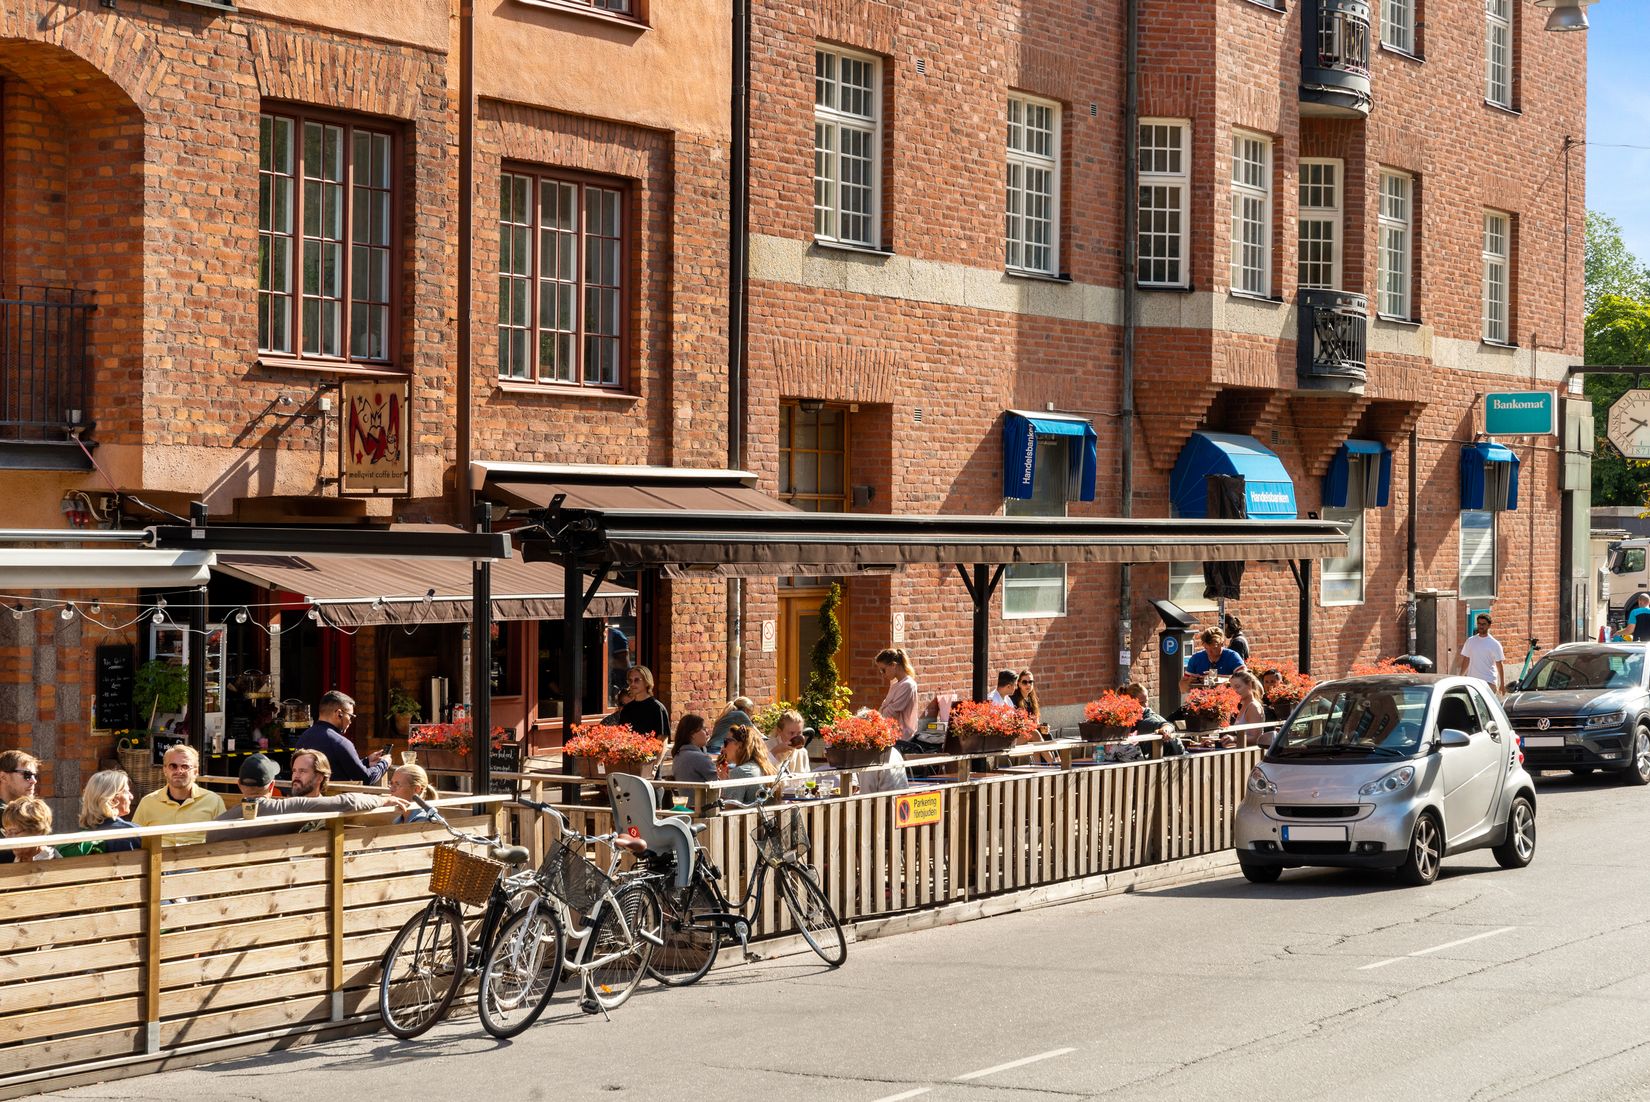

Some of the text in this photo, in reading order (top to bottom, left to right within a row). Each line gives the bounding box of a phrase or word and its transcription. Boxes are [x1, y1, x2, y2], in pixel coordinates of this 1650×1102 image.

[1493, 398, 1544, 410] Bankomat
[1022, 423, 1034, 485] Handelsbanken
[392, 470, 403, 478] bar
[1250, 490, 1290, 504] Handelsbanken
[1166, 640, 1174, 652] P
[914, 797, 937, 808] Parkering
[914, 808, 937, 819] förbjuden
